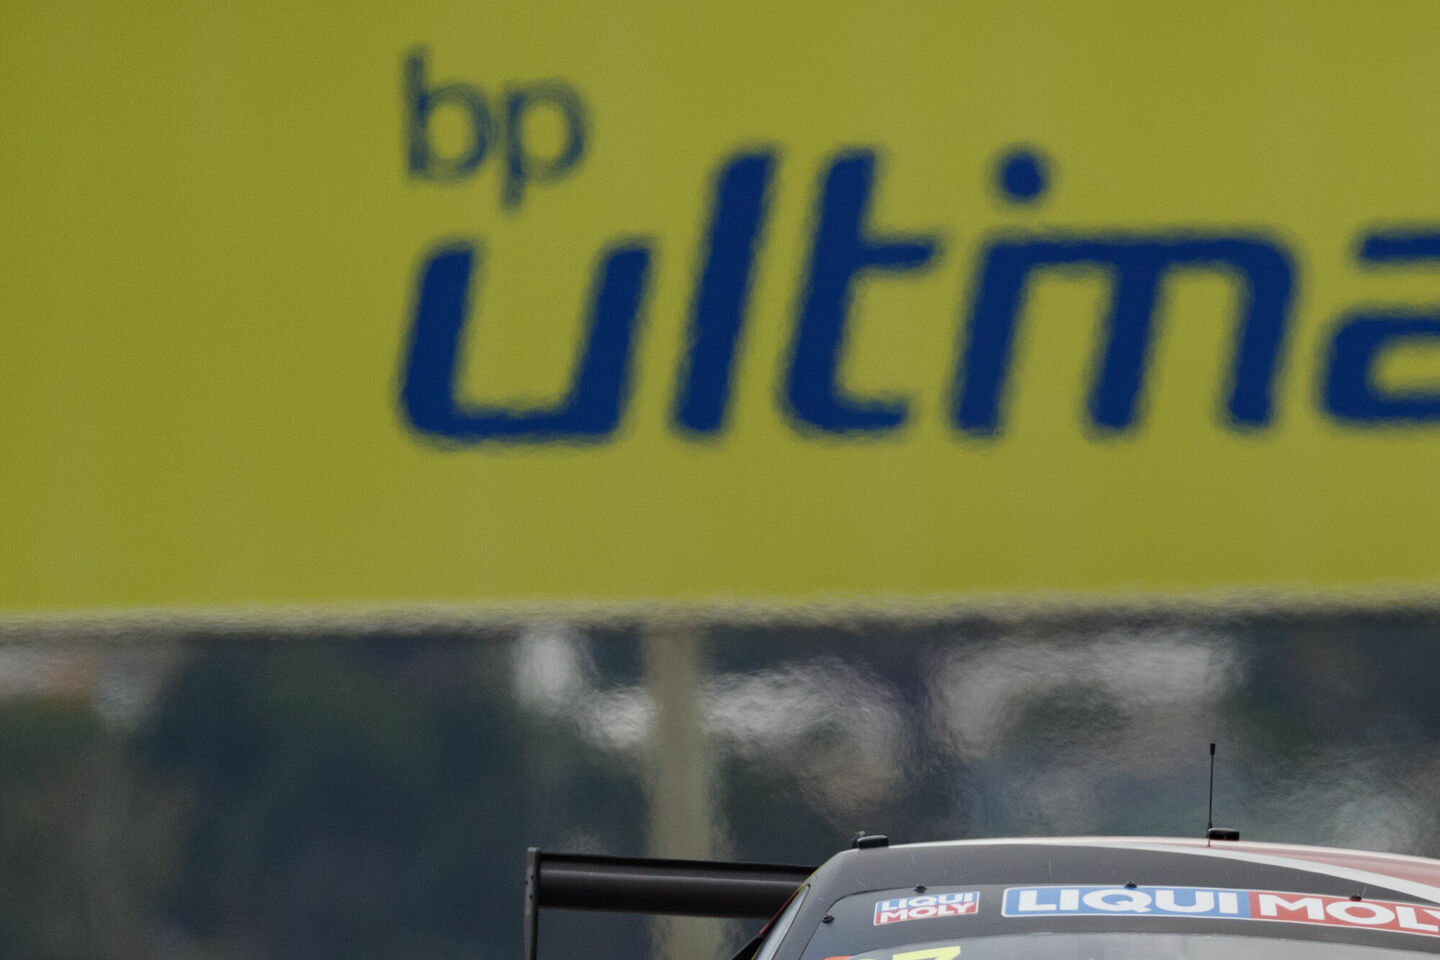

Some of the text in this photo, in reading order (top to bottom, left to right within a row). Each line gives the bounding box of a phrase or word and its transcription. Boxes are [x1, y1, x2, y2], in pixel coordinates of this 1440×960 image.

[405, 48, 594, 214] bp
[881, 891, 974, 911] LIQUI
[1018, 889, 1238, 914] LIQUI
[880, 902, 975, 924] MOLY
